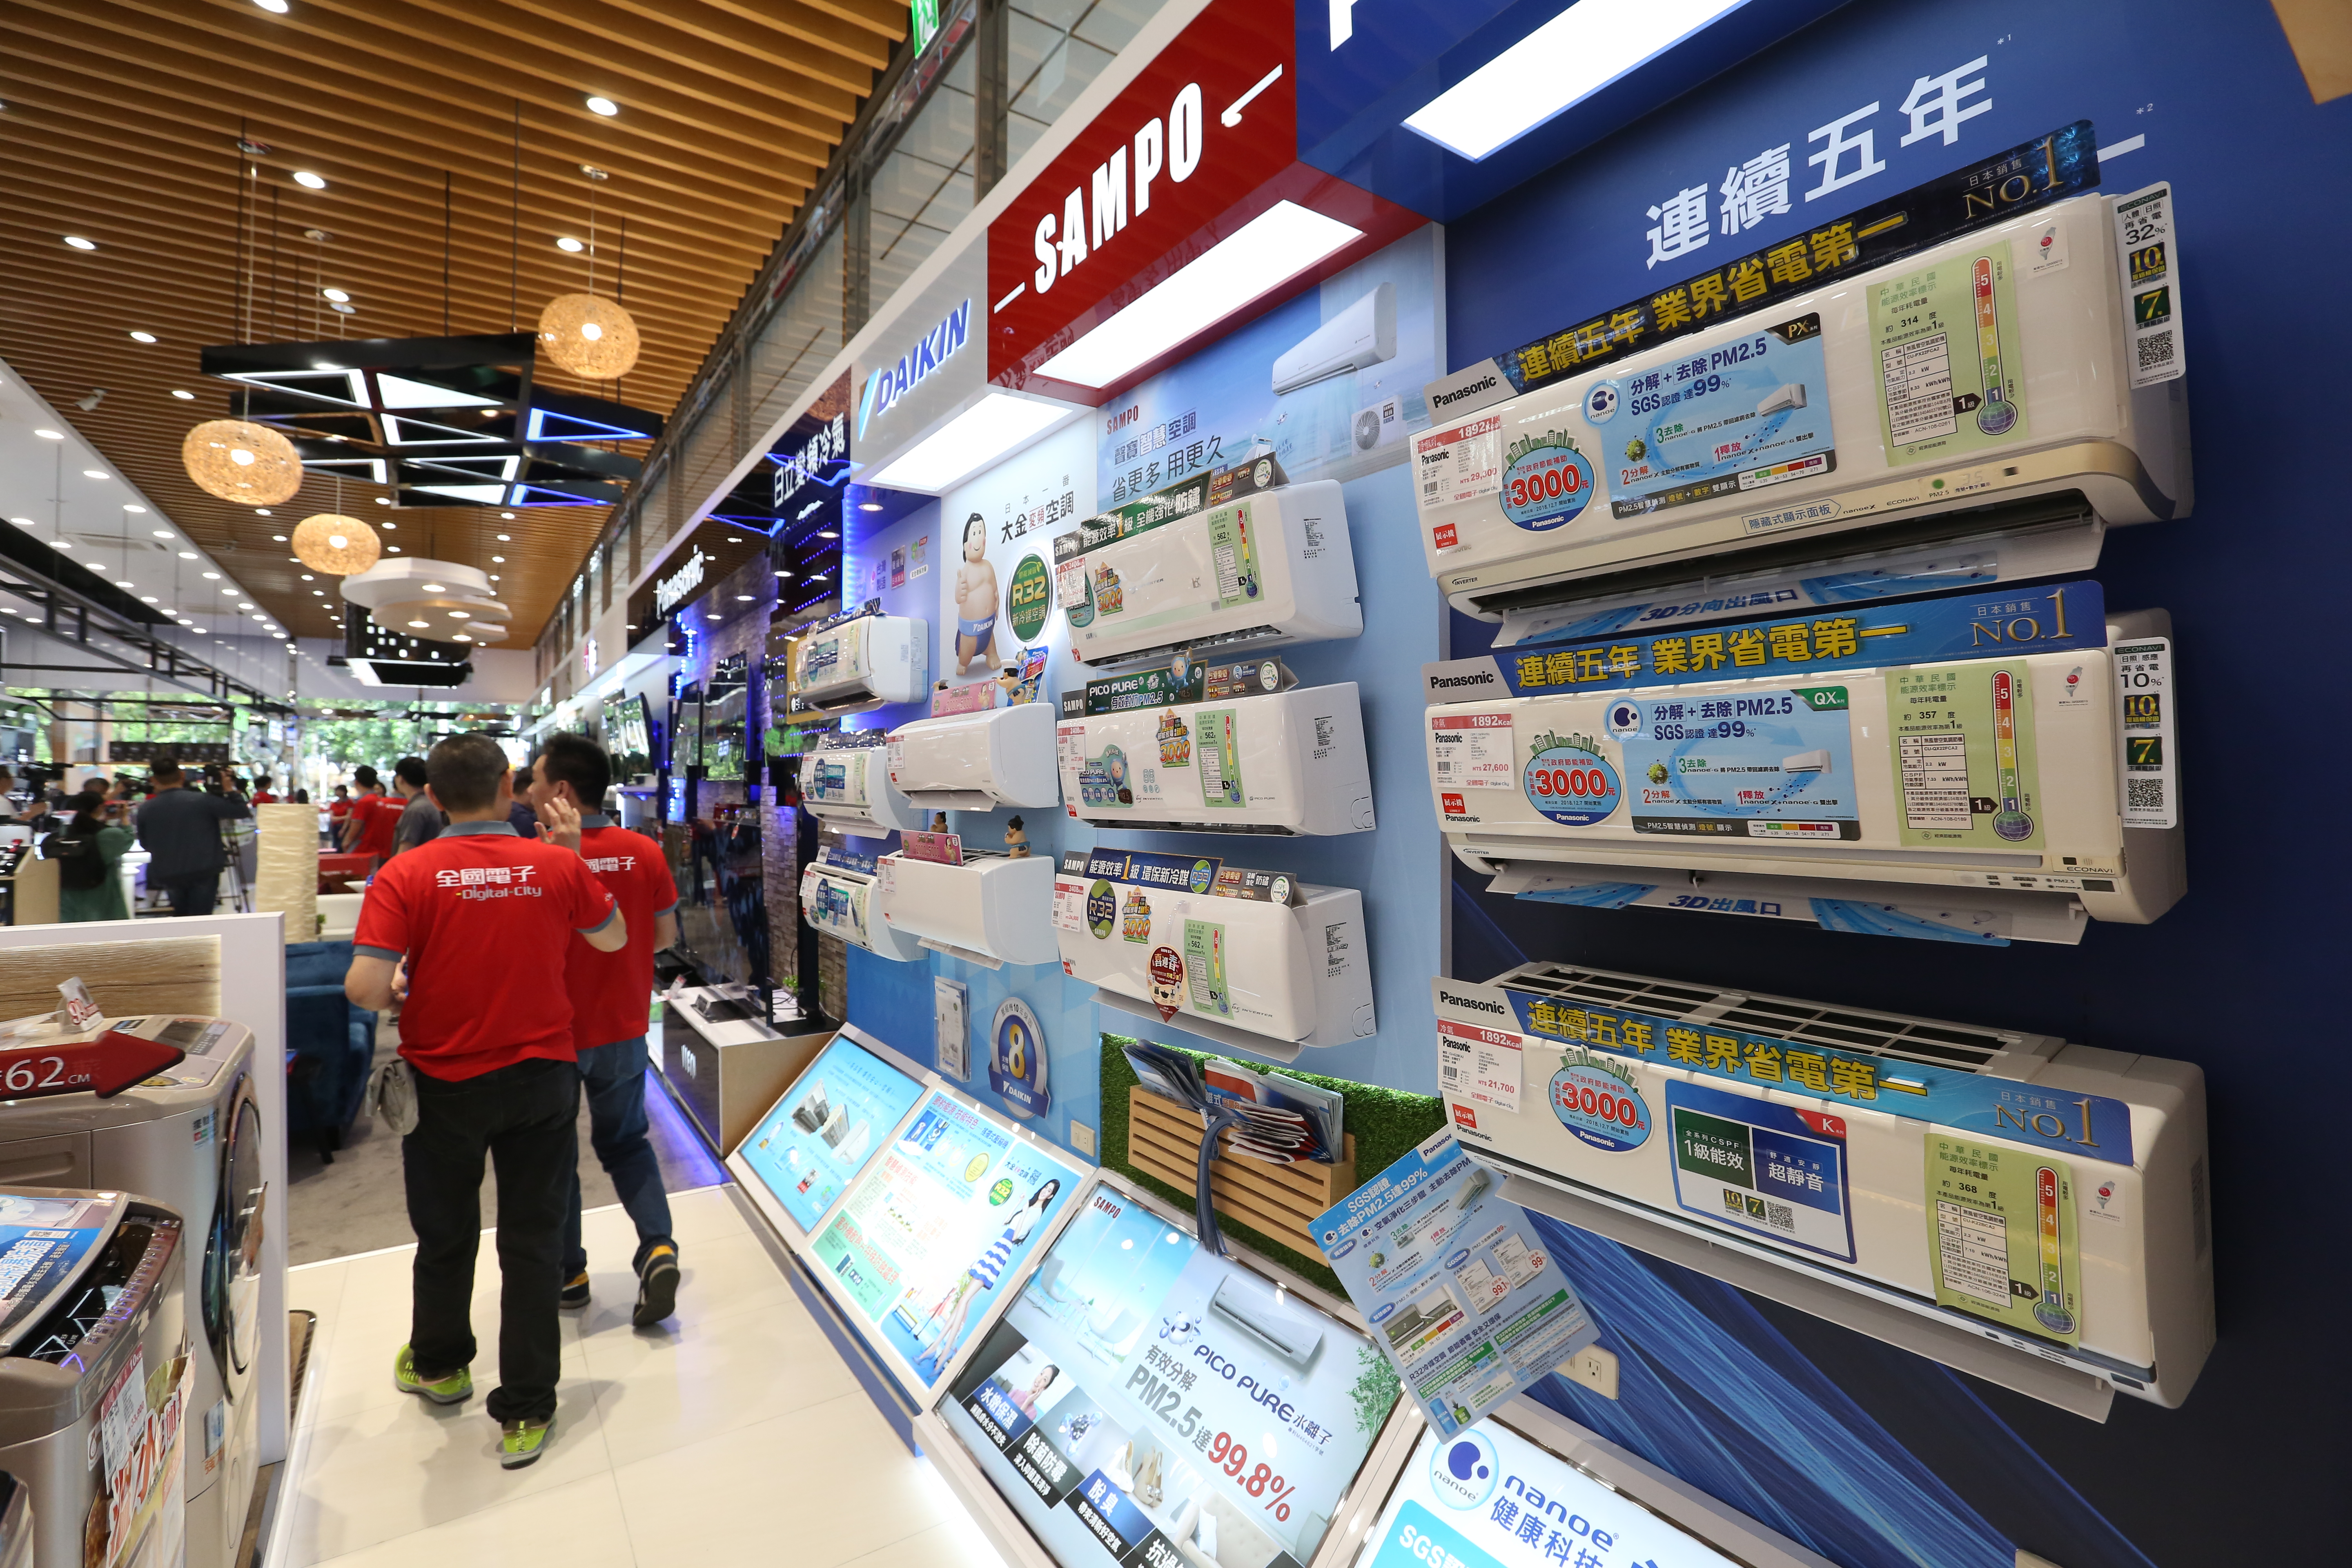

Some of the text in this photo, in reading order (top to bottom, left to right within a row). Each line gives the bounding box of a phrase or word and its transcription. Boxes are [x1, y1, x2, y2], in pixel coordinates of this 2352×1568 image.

[1646, 54, 1993, 270] 連續五年
[1969, 158, 2022, 187] 日本銷售
[1034, 82, 1203, 294] SAMPO
[1962, 136, 2065, 219] NO.1
[2120, 190, 2165, 212] ECONAVI
[2126, 223, 2165, 245] 32%
[1980, 274, 1989, 286] 5
[1517, 214, 1905, 383] 連續五年 業界省電第一
[1881, 281, 1937, 306] 能源效率標示
[1891, 297, 1928, 314] 每年耗電量
[1983, 304, 1991, 315] 4
[1788, 320, 1809, 338] PX
[1901, 311, 1937, 328] 314 度
[877, 298, 971, 416] DAIKIN
[1630, 337, 1767, 396] 分解 PM2.5
[1432, 375, 1497, 408] Panasonic
[1107, 405, 1139, 435] SAMPO
[1590, 408, 1615, 419] nanoe
[1114, 410, 1196, 466] 聲寶智慧空調
[1112, 434, 1225, 503] 省更多 用更久
[1422, 449, 1449, 466] Panasonic
[1526, 455, 1567, 472] 政府節能補助
[1005, 474, 1070, 514] 日本一番
[1511, 463, 1581, 508] 3000
[1929, 490, 1950, 499] PM2.5
[1886, 496, 1920, 506] ECONAVI
[1000, 491, 1074, 544] 大金變頻空調
[1532, 516, 1565, 528] Panasonic
[1748, 504, 1831, 530] 隱藏式顯示面板
[1083, 511, 1133, 548] 能源效率1級
[1217, 532, 1226, 541] 562
[1435, 528, 1456, 541] 展示機
[1012, 575, 1047, 607] R32
[1097, 588, 1123, 611] 3000
[1640, 588, 1799, 621] 3D分向出風口
[1977, 601, 2031, 616] 日本銷售
[977, 619, 993, 633] DAIKIN
[1012, 604, 1046, 628] 新冷媒空調
[1970, 588, 2074, 647] NO.1
[1515, 617, 1907, 689] 連續五年 業界省電第一
[2118, 645, 2162, 653] ECONAVI
[2121, 664, 2159, 672] 再省電
[1089, 680, 1138, 696] PICO PURE
[1430, 671, 1494, 689] Panasonic
[2120, 673, 2162, 688] 10%
[1063, 699, 1083, 712] SAMPO
[1111, 691, 1163, 710] 有效對抗PM2.5
[1654, 697, 1793, 721] 分解 PM2.5
[1814, 692, 1837, 706] QX
[1910, 695, 1947, 704] 每年耗電量
[1432, 716, 1512, 728] 冷氣 1892Kcal
[1919, 711, 1937, 719] 357
[1435, 733, 1463, 744] Panasonic
[1160, 740, 1190, 762] 3000
[1483, 763, 1508, 772] 27,600
[1534, 769, 1606, 797] 3000
[1444, 798, 1463, 808] 展示機
[1445, 814, 1480, 823] Panasonic
[1556, 813, 1590, 822] Panasonic
[435, 865, 536, 888] 全國電子
[1064, 859, 1084, 872] SAMPO
[1089, 854, 1209, 886] 能源效率1級 環保新冷媒 R32
[1089, 899, 1113, 919] R32
[1668, 895, 1782, 918] 3D出風口
[1123, 919, 1150, 936] 3000
[1440, 991, 1505, 1015] Panasonic
[1440, 1024, 1522, 1049] 冷氣 1892Kcal
[1443, 1036, 1471, 1053] Panasonic
[1528, 1000, 1928, 1100] 連續五年 業界省電第一
[1009, 1086, 1031, 1104] DAIKIN
[1488, 1080, 1515, 1093] 21,700
[1580, 1076, 1625, 1094] 政府節能補助
[1471, 1092, 1493, 1103] 全國電子
[1561, 1081, 1645, 1131] 3000 元
[2000, 1091, 2057, 1110] 日本銷售
[1455, 1109, 1474, 1123] 展示機
[1822, 1118, 1835, 1133] K
[1993, 1098, 2100, 1147] NO.1
[1580, 1130, 1615, 1148] Panasonic
[1684, 1140, 1744, 1172] 1級能效
[1768, 1162, 1824, 1193] 超靜音
[1337, 1167, 1428, 1236] 去除PM2.5達99%
[1347, 1177, 1392, 1213] SGS認證
[1958, 1182, 1997, 1199] 368 度
[1092, 1196, 1122, 1219] SAMPO
[1374, 1189, 1428, 1231] 空氣淨化三步驟
[1962, 1217, 1996, 1230] CU-K22BCA2
[1146, 1344, 1197, 1392] 有效分解
[1193, 1344, 1236, 1381] PICO
[1237, 1378, 1295, 1423] PURE
[980, 1386, 1019, 1430] 水嫩保濕
[1125, 1363, 1203, 1438] PM2.5
[1207, 1431, 1292, 1522] 99.8%
[1022, 1432, 1068, 1483] 除菌防霉
[1433, 1470, 1479, 1502] nanoe
